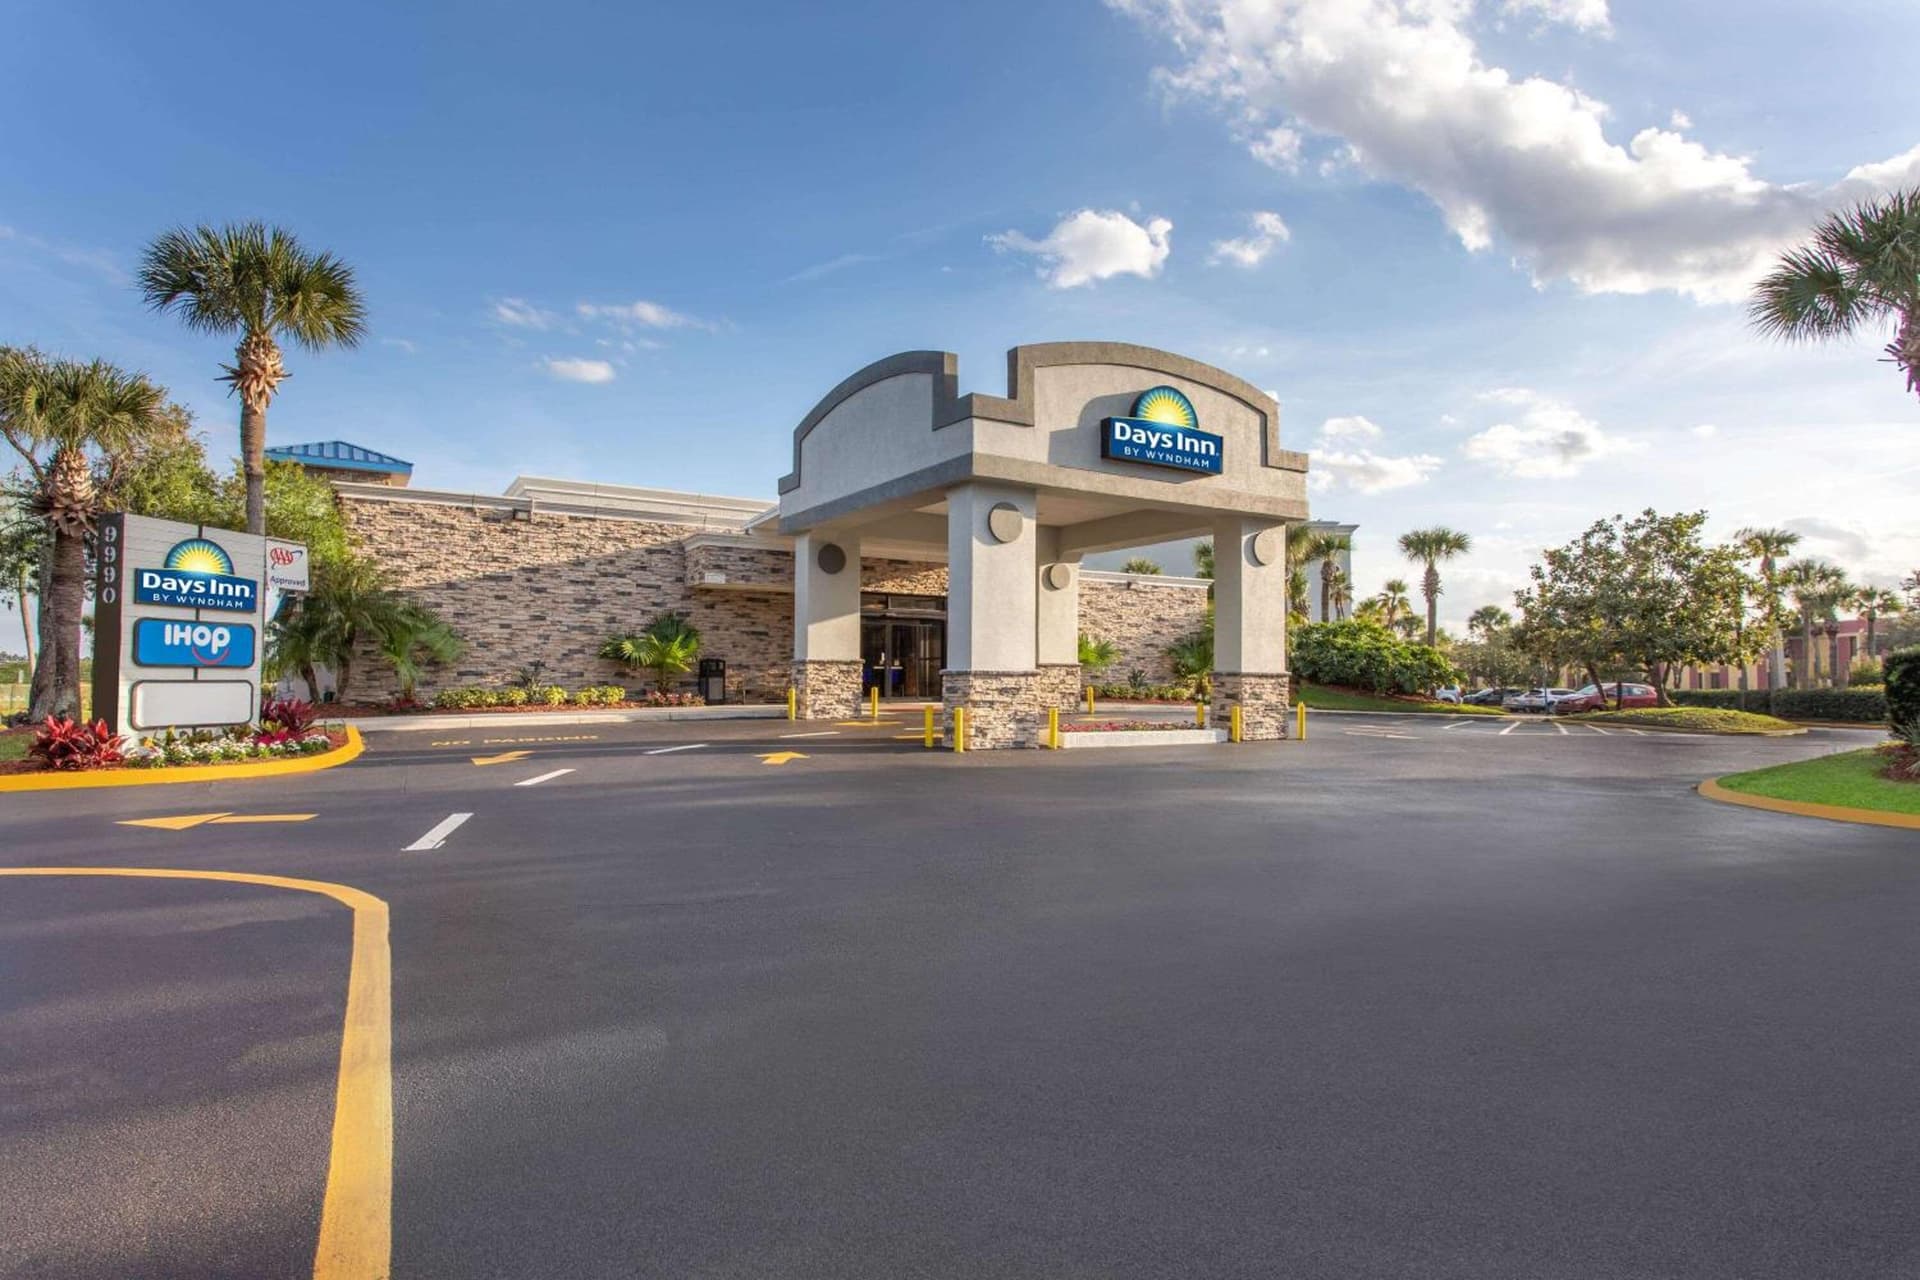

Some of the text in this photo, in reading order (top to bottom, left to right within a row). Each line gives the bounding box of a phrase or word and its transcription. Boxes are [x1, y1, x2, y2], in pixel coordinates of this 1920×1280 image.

[1114, 421, 1216, 456] Days Inn
[1124, 446, 1210, 468] BY WYNDHAM
[102, 526, 117, 603] 9990
[270, 547, 294, 566] AAA
[143, 572, 250, 598] Days Inn
[270, 575, 306, 587] Approved
[153, 593, 244, 609] BY WYNDHAM
[164, 624, 231, 655] IHOP
